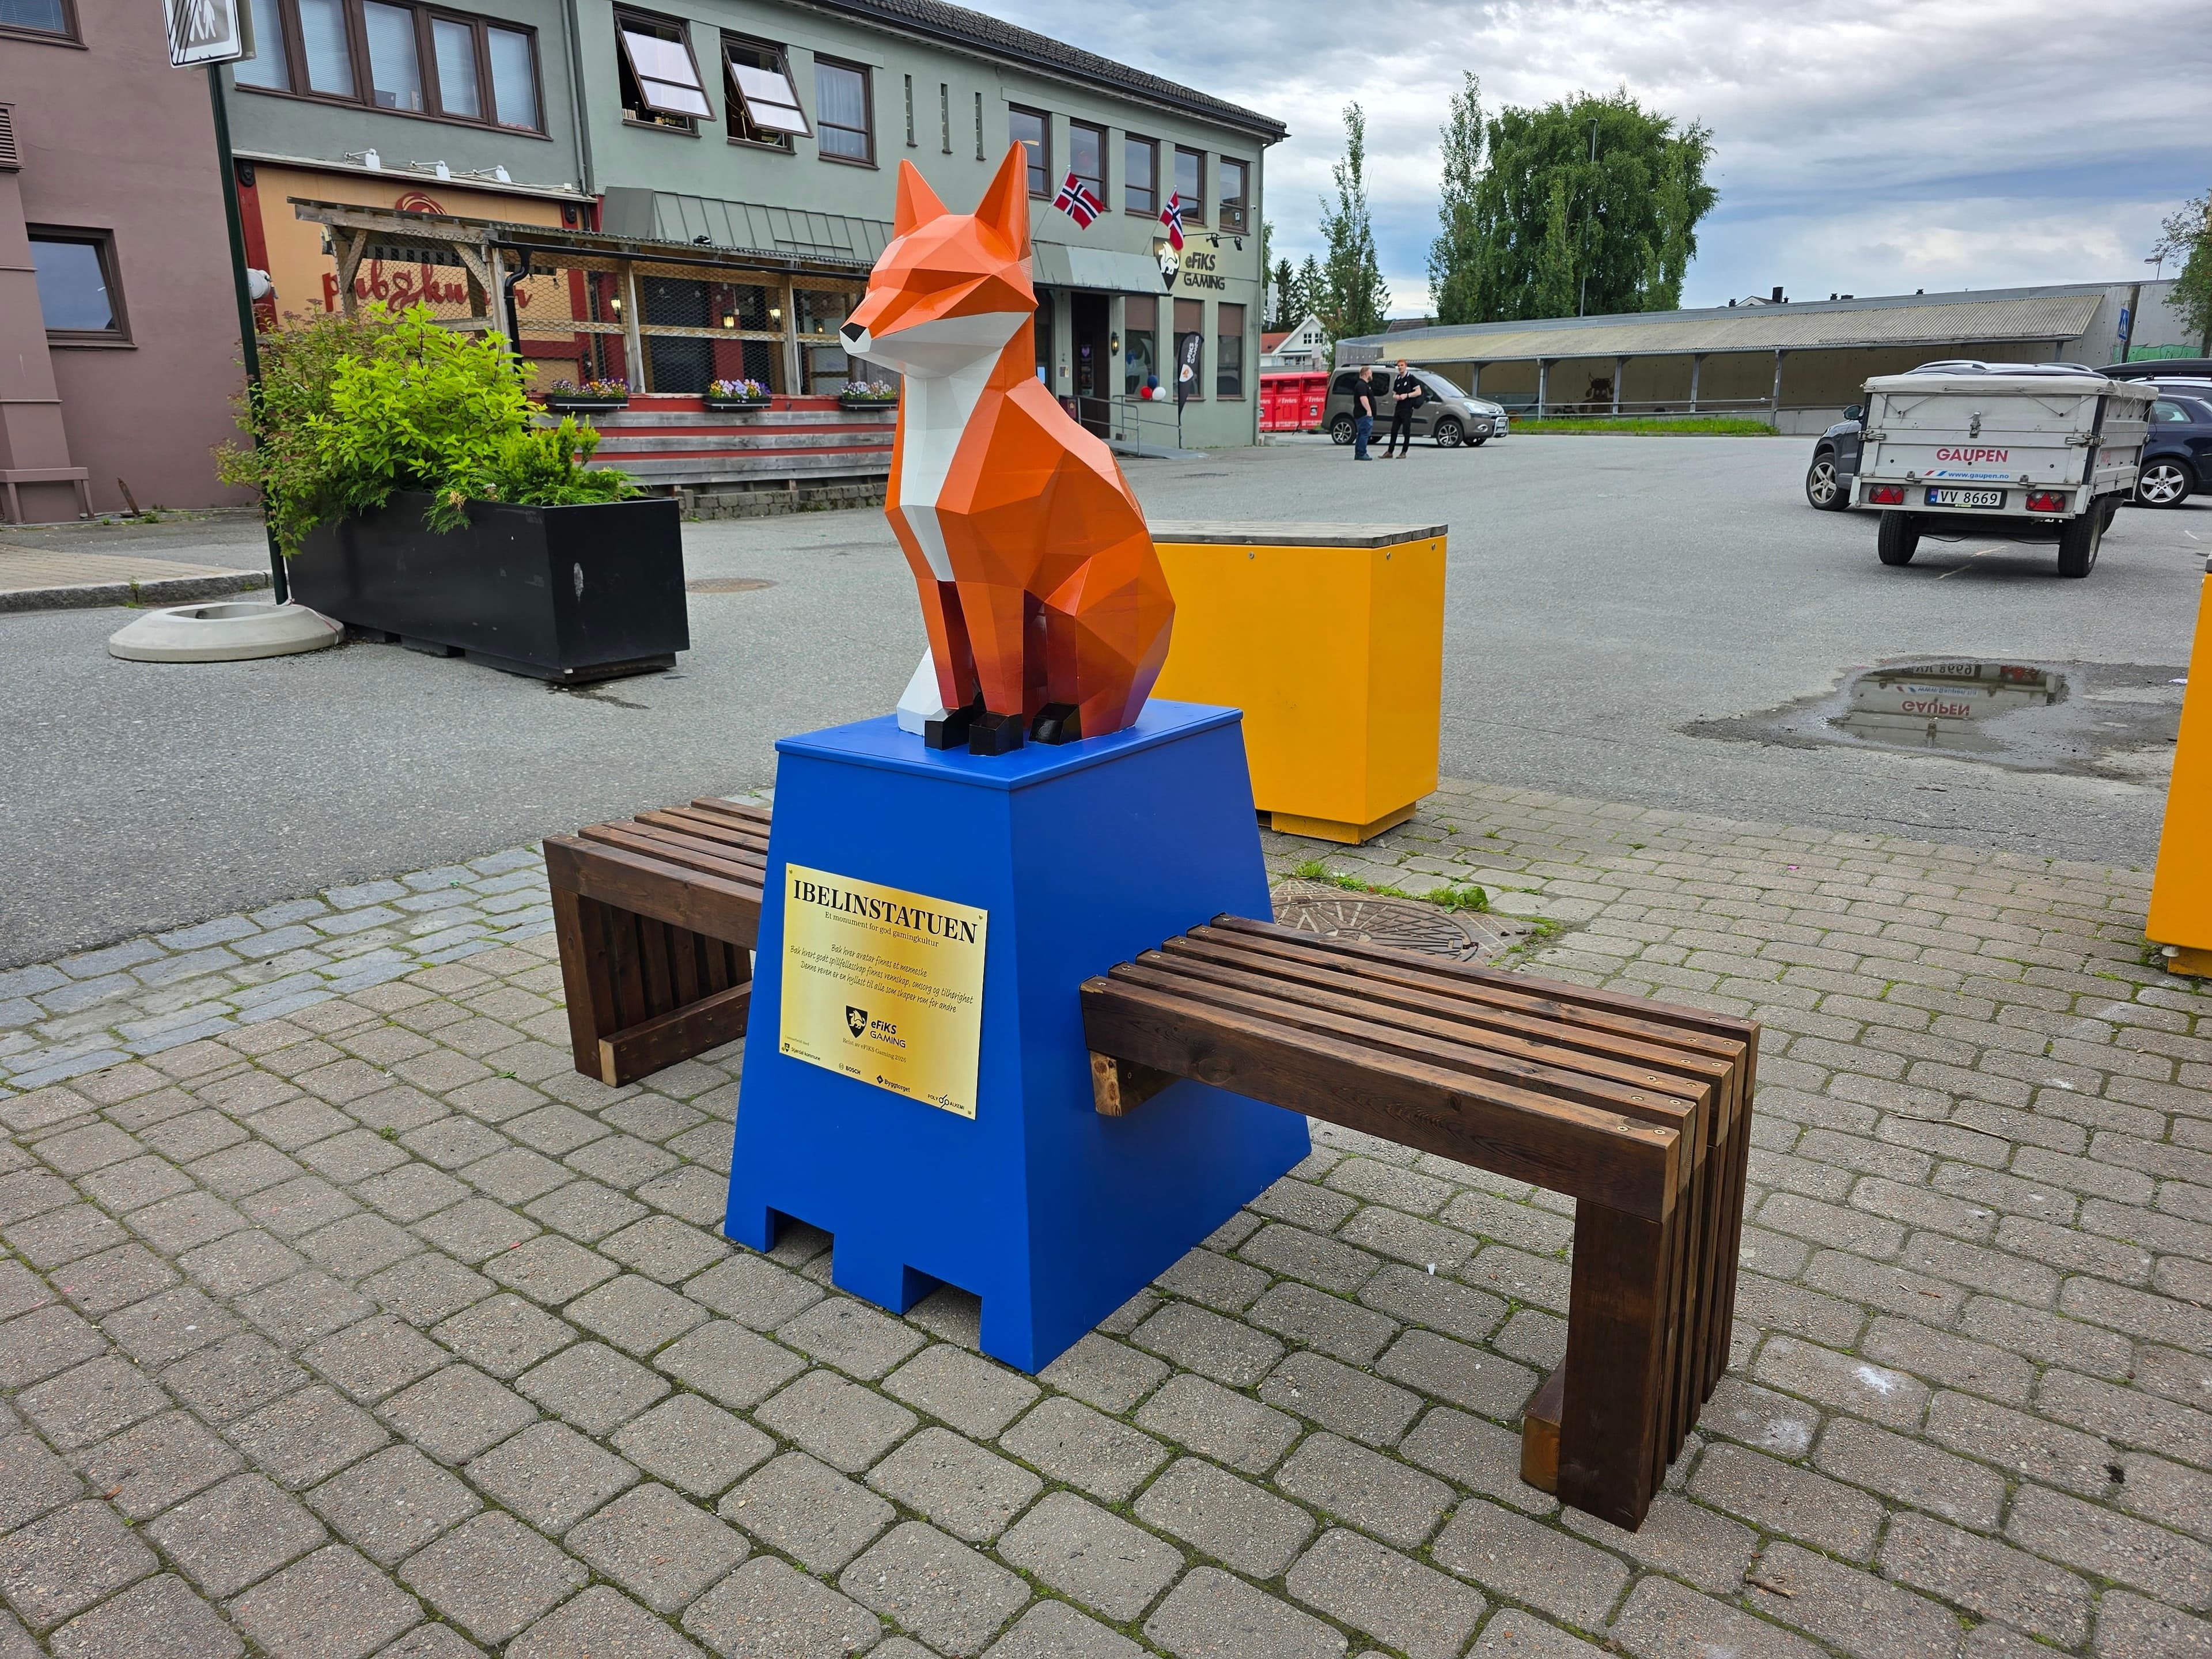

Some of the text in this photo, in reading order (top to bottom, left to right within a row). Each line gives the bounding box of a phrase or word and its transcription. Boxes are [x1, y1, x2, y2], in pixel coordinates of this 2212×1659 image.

[1185, 252, 1216, 271] eFiKS
[1184, 272, 1225, 290] GAMING
[1936, 448, 2009, 462] GAUPEN
[1941, 491, 1959, 502] VV
[1963, 492, 1998, 505] 8669
[793, 879, 978, 944] IBELINSTATUEN
[825, 911, 832, 919] Et
[833, 915, 868, 929] monument
[869, 923, 879, 932] for
[892, 930, 939, 947] gamingkultur
[831, 944, 927, 978] Bak hver avatar finnes et menneske
[790, 945, 974, 1004] Bak hvert godt spillfellesskap finnes vennskap, omsorg og tilhørighet
[801, 960, 817, 972] Denne
[817, 966, 832, 976] reven
[847, 974, 866, 986] hyllest
[874, 983, 885, 992] alle
[885, 987, 897, 995] som
[897, 989, 916, 1001] skaper
[929, 997, 939, 1008] for
[939, 1001, 957, 1013] andre
[871, 1020, 897, 1035] eFiKS
[870, 1031, 906, 1048] GAMING
[875, 1048, 895, 1060] Gaming
[846, 1065, 861, 1075] BOSCH
[884, 1078, 910, 1093] Byggtorget
